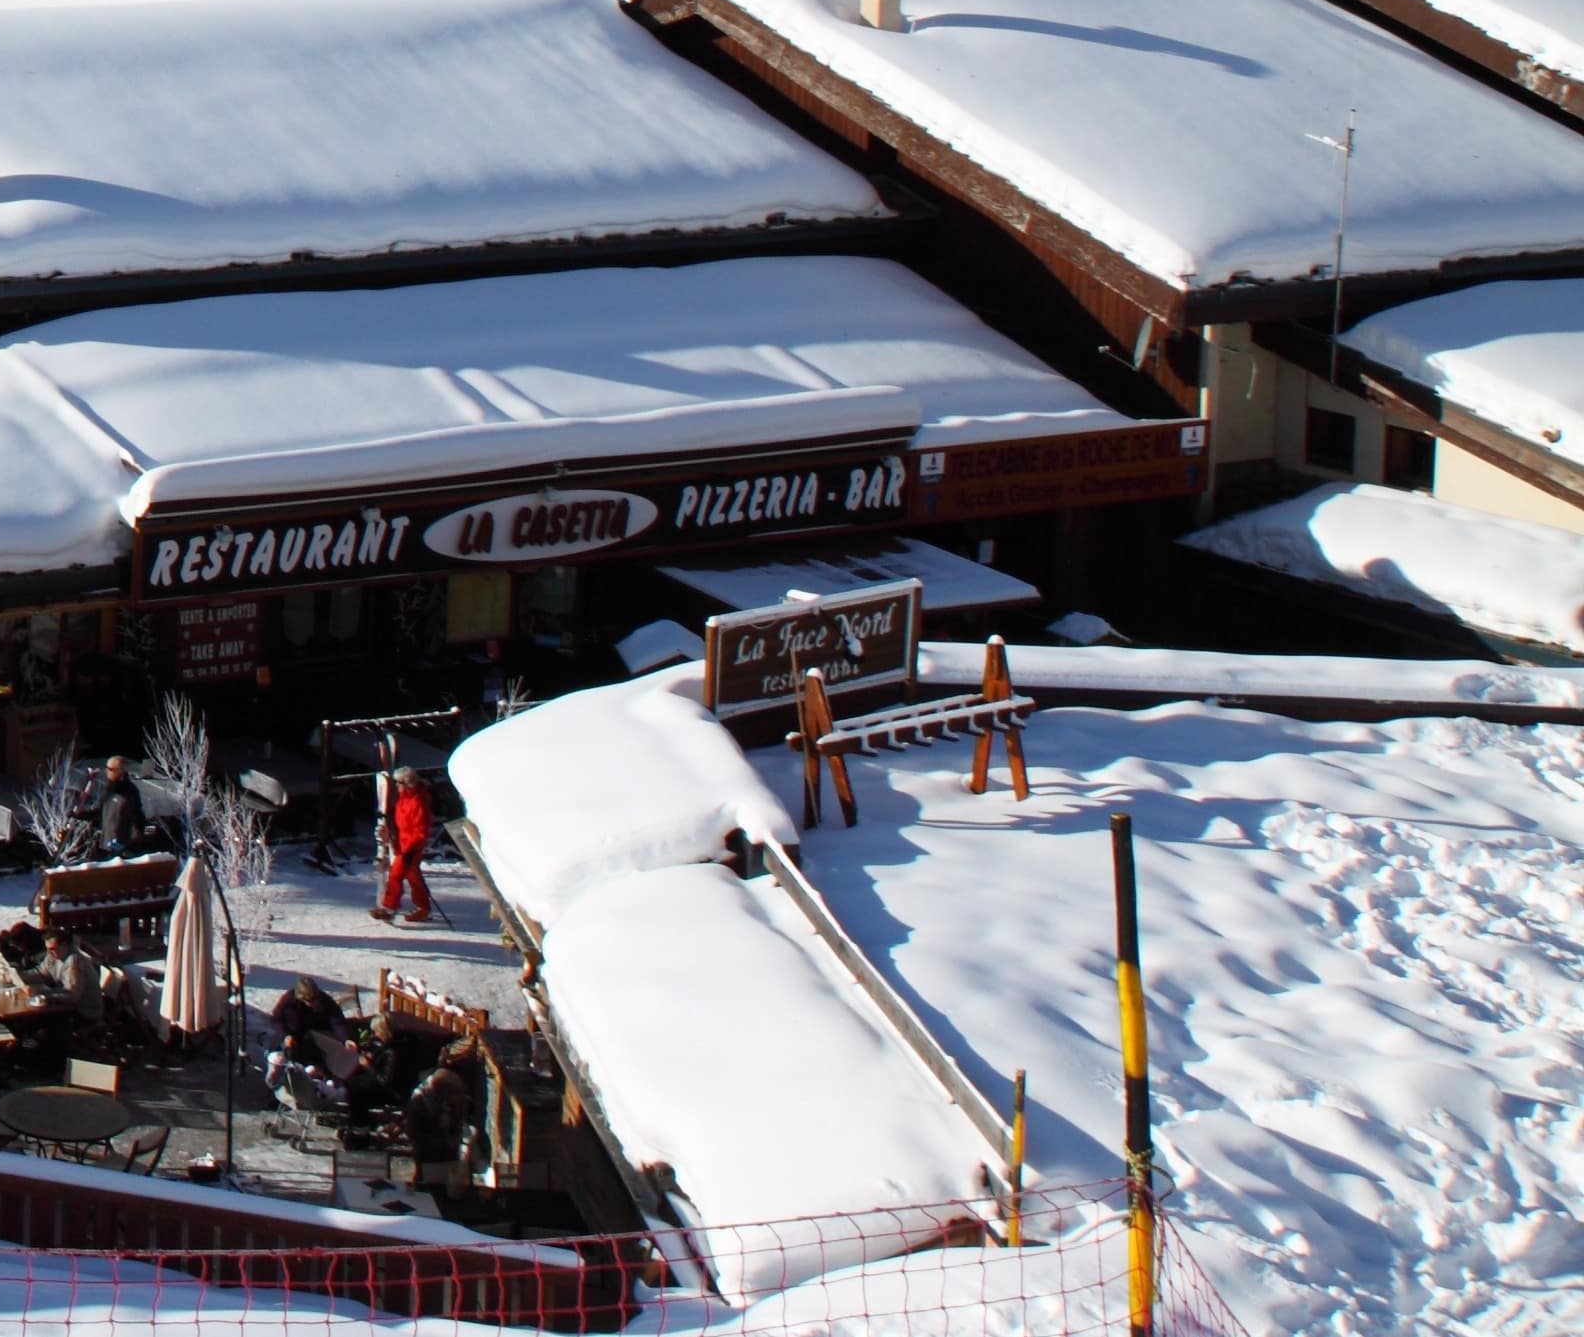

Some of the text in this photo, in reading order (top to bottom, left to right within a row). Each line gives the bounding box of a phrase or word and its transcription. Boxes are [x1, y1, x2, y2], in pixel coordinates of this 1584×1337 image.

[675, 471, 819, 529] PIZZERIA
[844, 456, 906, 511] BAR
[149, 515, 410, 586] RESTAURANT
[457, 497, 631, 556] LA CASETTA
[190, 639, 245, 662] TAKE AWAY
[734, 602, 897, 664] La Face Nord
[762, 658, 860, 694] restarant
